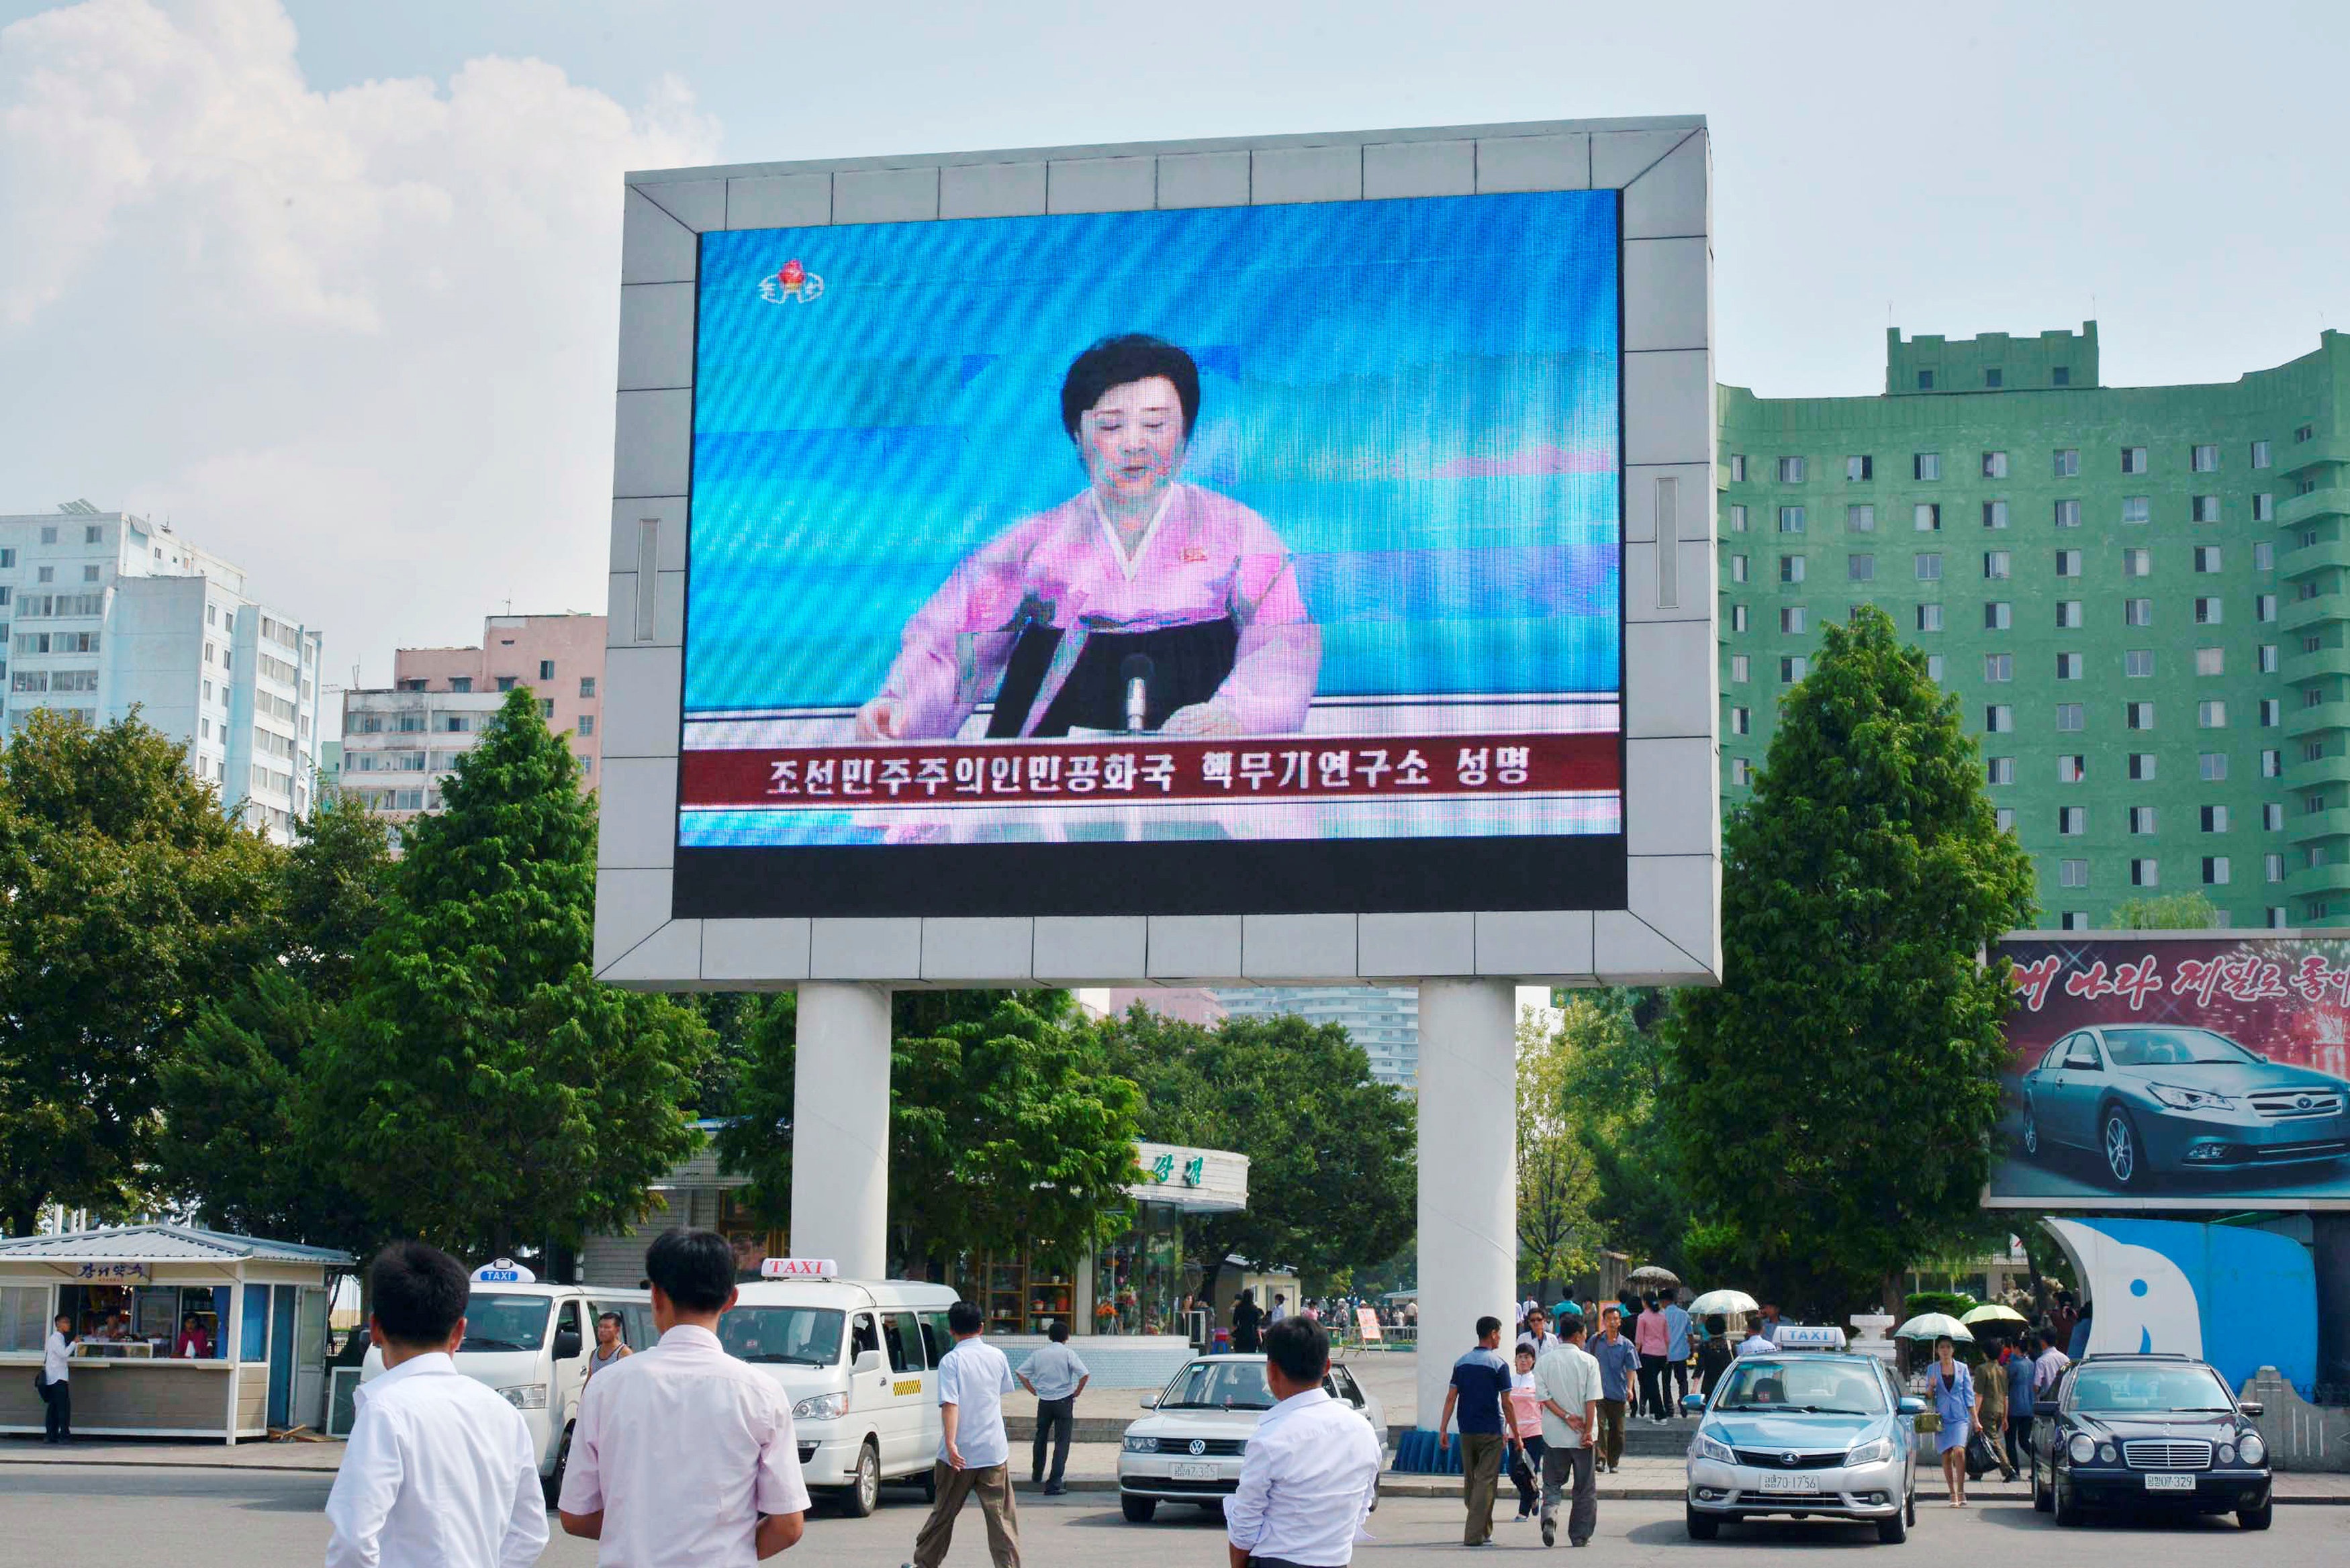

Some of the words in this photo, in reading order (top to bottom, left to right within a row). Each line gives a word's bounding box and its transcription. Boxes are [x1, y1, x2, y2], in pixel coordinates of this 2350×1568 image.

[766, 752, 1175, 795] 조선민주주의인민공화국
[1203, 748, 1431, 791] 핵무기연구소
[1457, 746, 1530, 785] 성명
[2065, 954, 2163, 1010] 나라
[2171, 955, 2288, 1007] 제일로
[769, 1261, 824, 1274] TAXI
[487, 1271, 512, 1280] TAXI
[1789, 1330, 1828, 1340] TAXI
